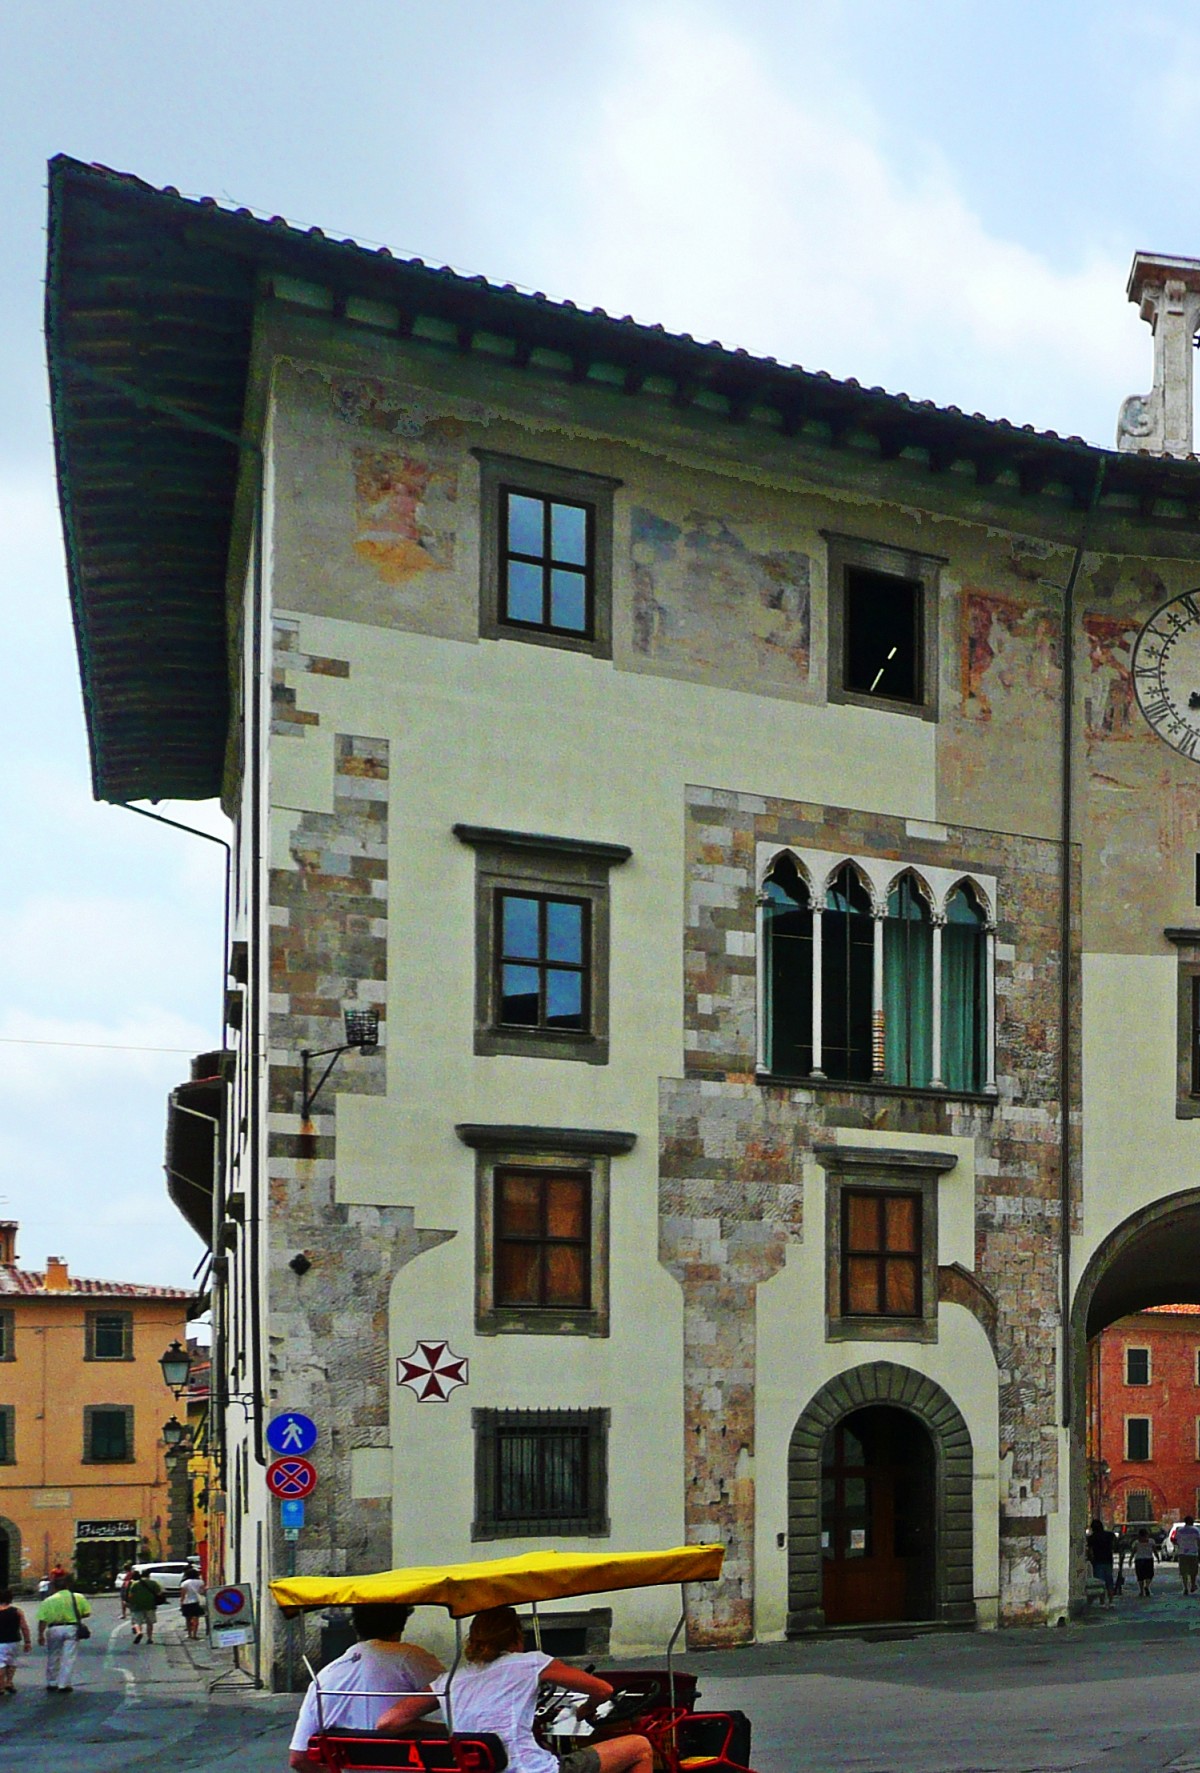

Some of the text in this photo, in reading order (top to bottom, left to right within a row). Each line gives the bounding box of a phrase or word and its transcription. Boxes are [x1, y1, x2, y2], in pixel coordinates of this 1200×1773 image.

[1181, 595, 1200, 617] XI
[1146, 623, 1170, 642] X
[1135, 664, 1160, 678] IX
[1144, 699, 1170, 726] VIII
[1178, 730, 1199, 758] VII
